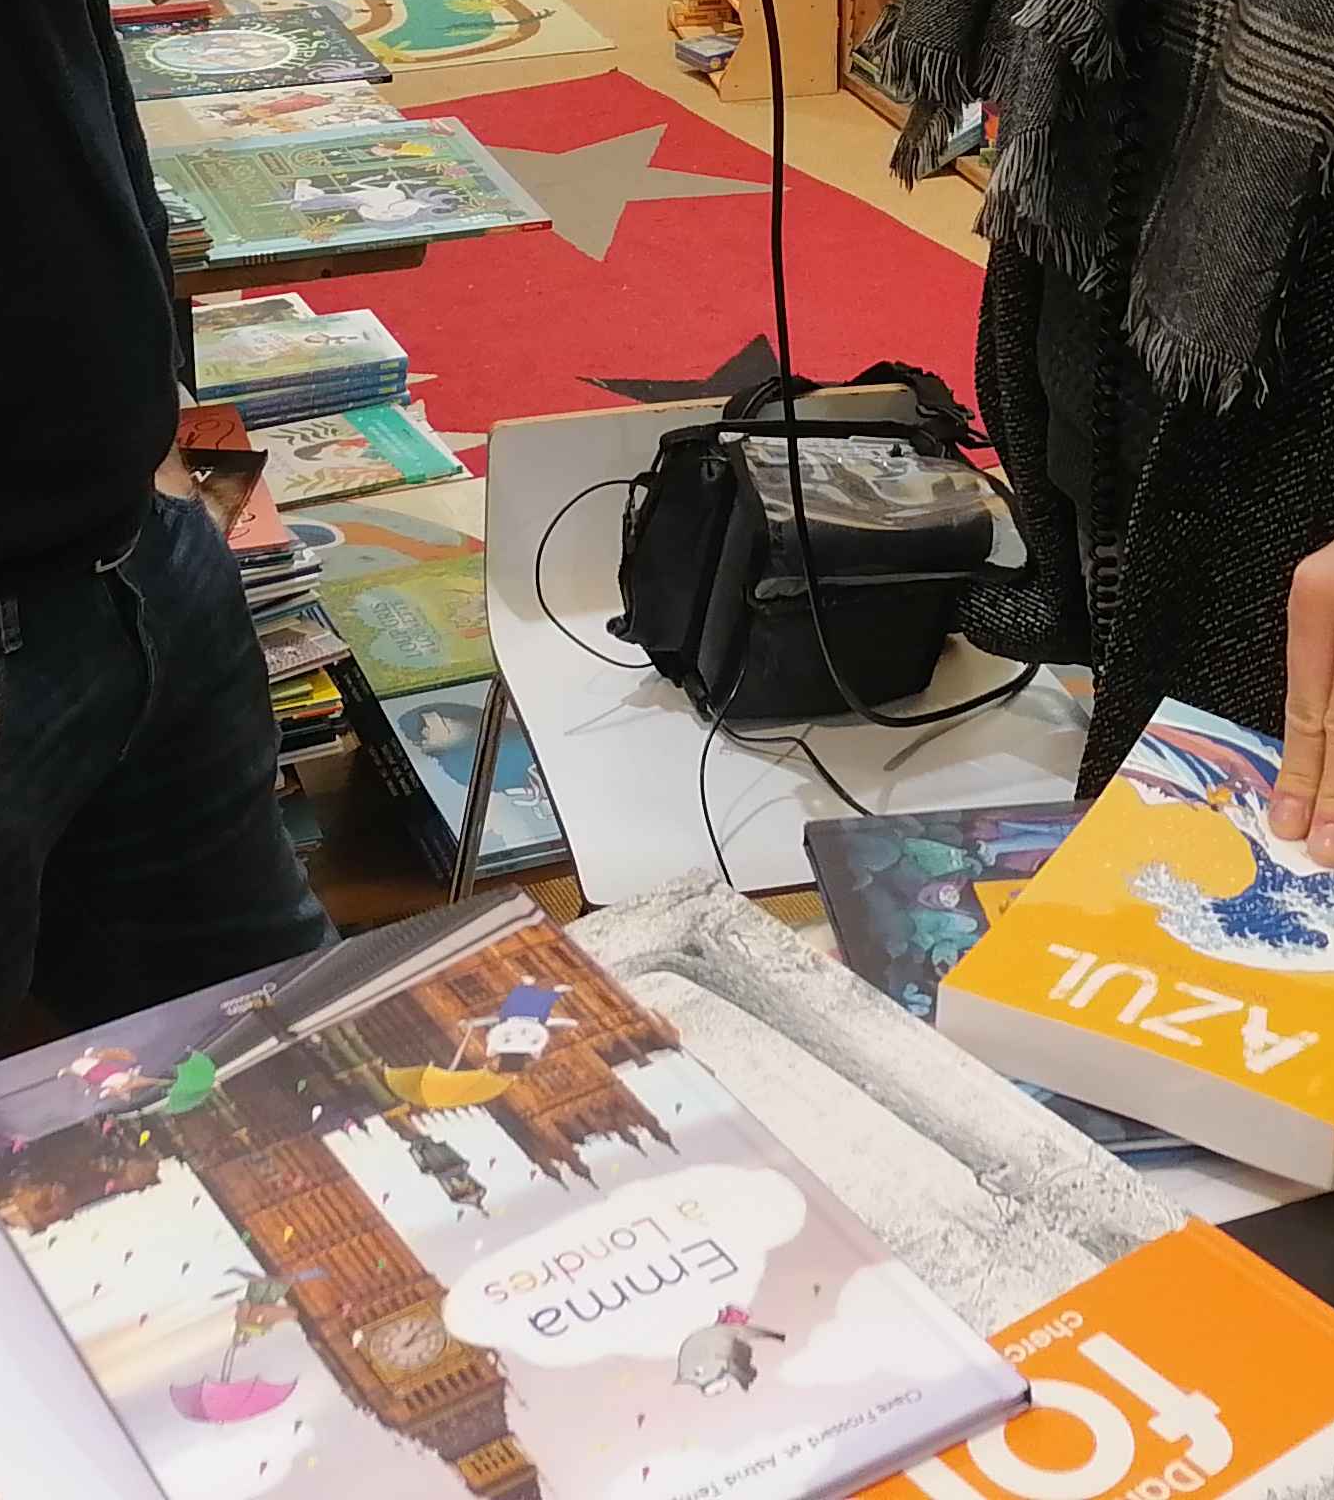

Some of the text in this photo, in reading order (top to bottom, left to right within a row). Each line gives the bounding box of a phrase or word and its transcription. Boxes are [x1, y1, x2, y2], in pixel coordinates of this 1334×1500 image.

[1043, 938, 1320, 1078] AZUL
[483, 1198, 706, 1308] à Londres
[526, 1236, 740, 1342] Emma
[872, 1387, 924, 1424] Claire
[719, 1450, 779, 1488] Astrid
